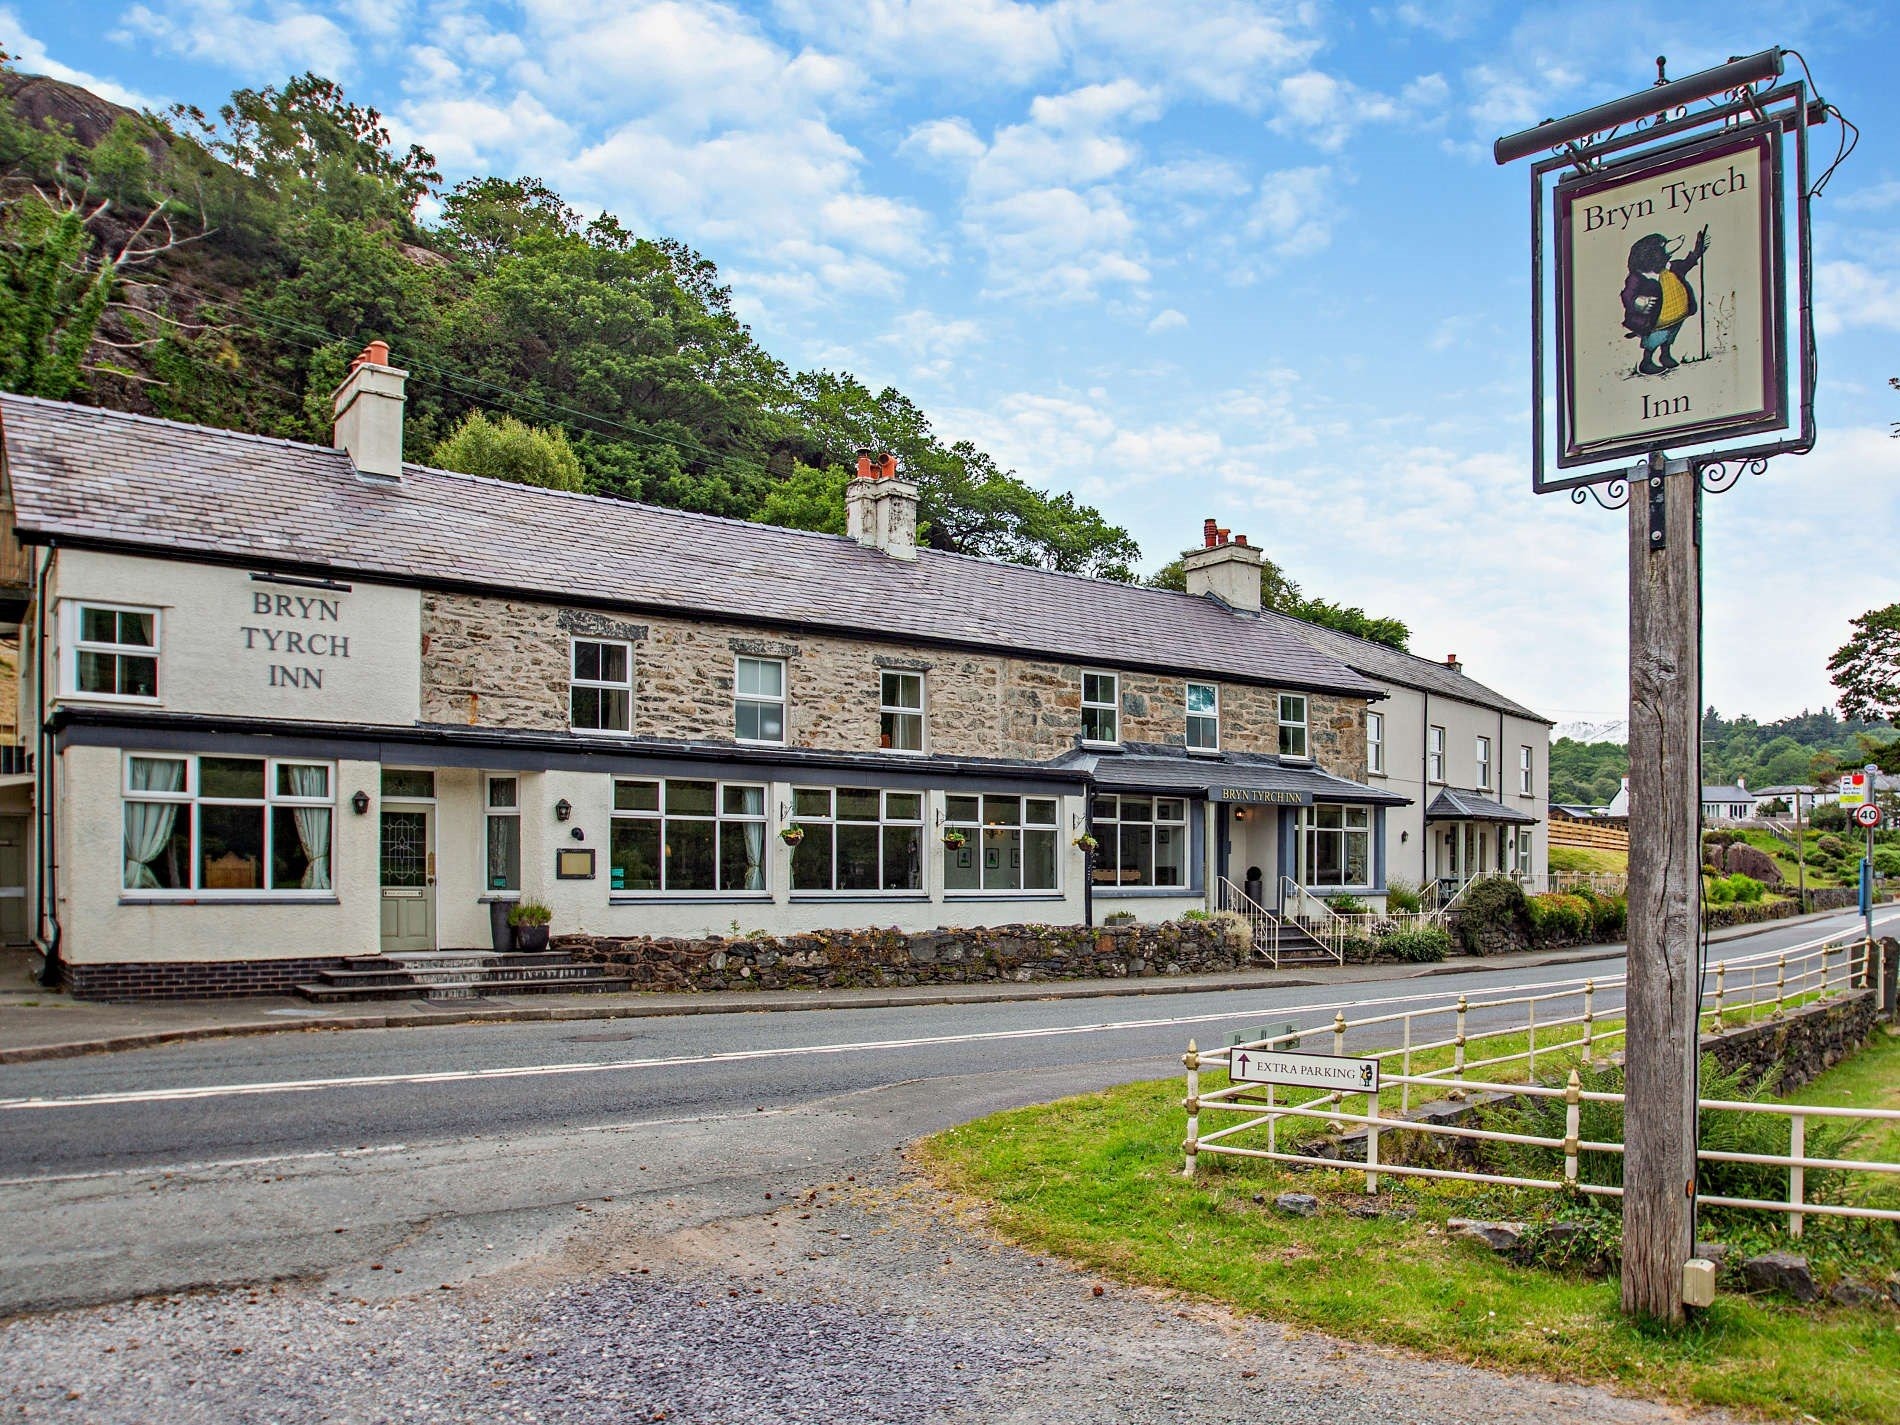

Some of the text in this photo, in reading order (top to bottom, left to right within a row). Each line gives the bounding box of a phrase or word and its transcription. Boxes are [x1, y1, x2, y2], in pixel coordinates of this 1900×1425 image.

[1583, 166, 1747, 233] Bryn Tyrch
[1641, 393, 1692, 420] Inn
[252, 591, 342, 622] BRYN
[239, 626, 351, 658] TYRCH
[268, 664, 325, 690] INN
[1222, 788, 1303, 804] BRYN TYRCH INN
[1859, 810, 1877, 820] 40
[1256, 1061, 1357, 1080] EXTRA PARKING
